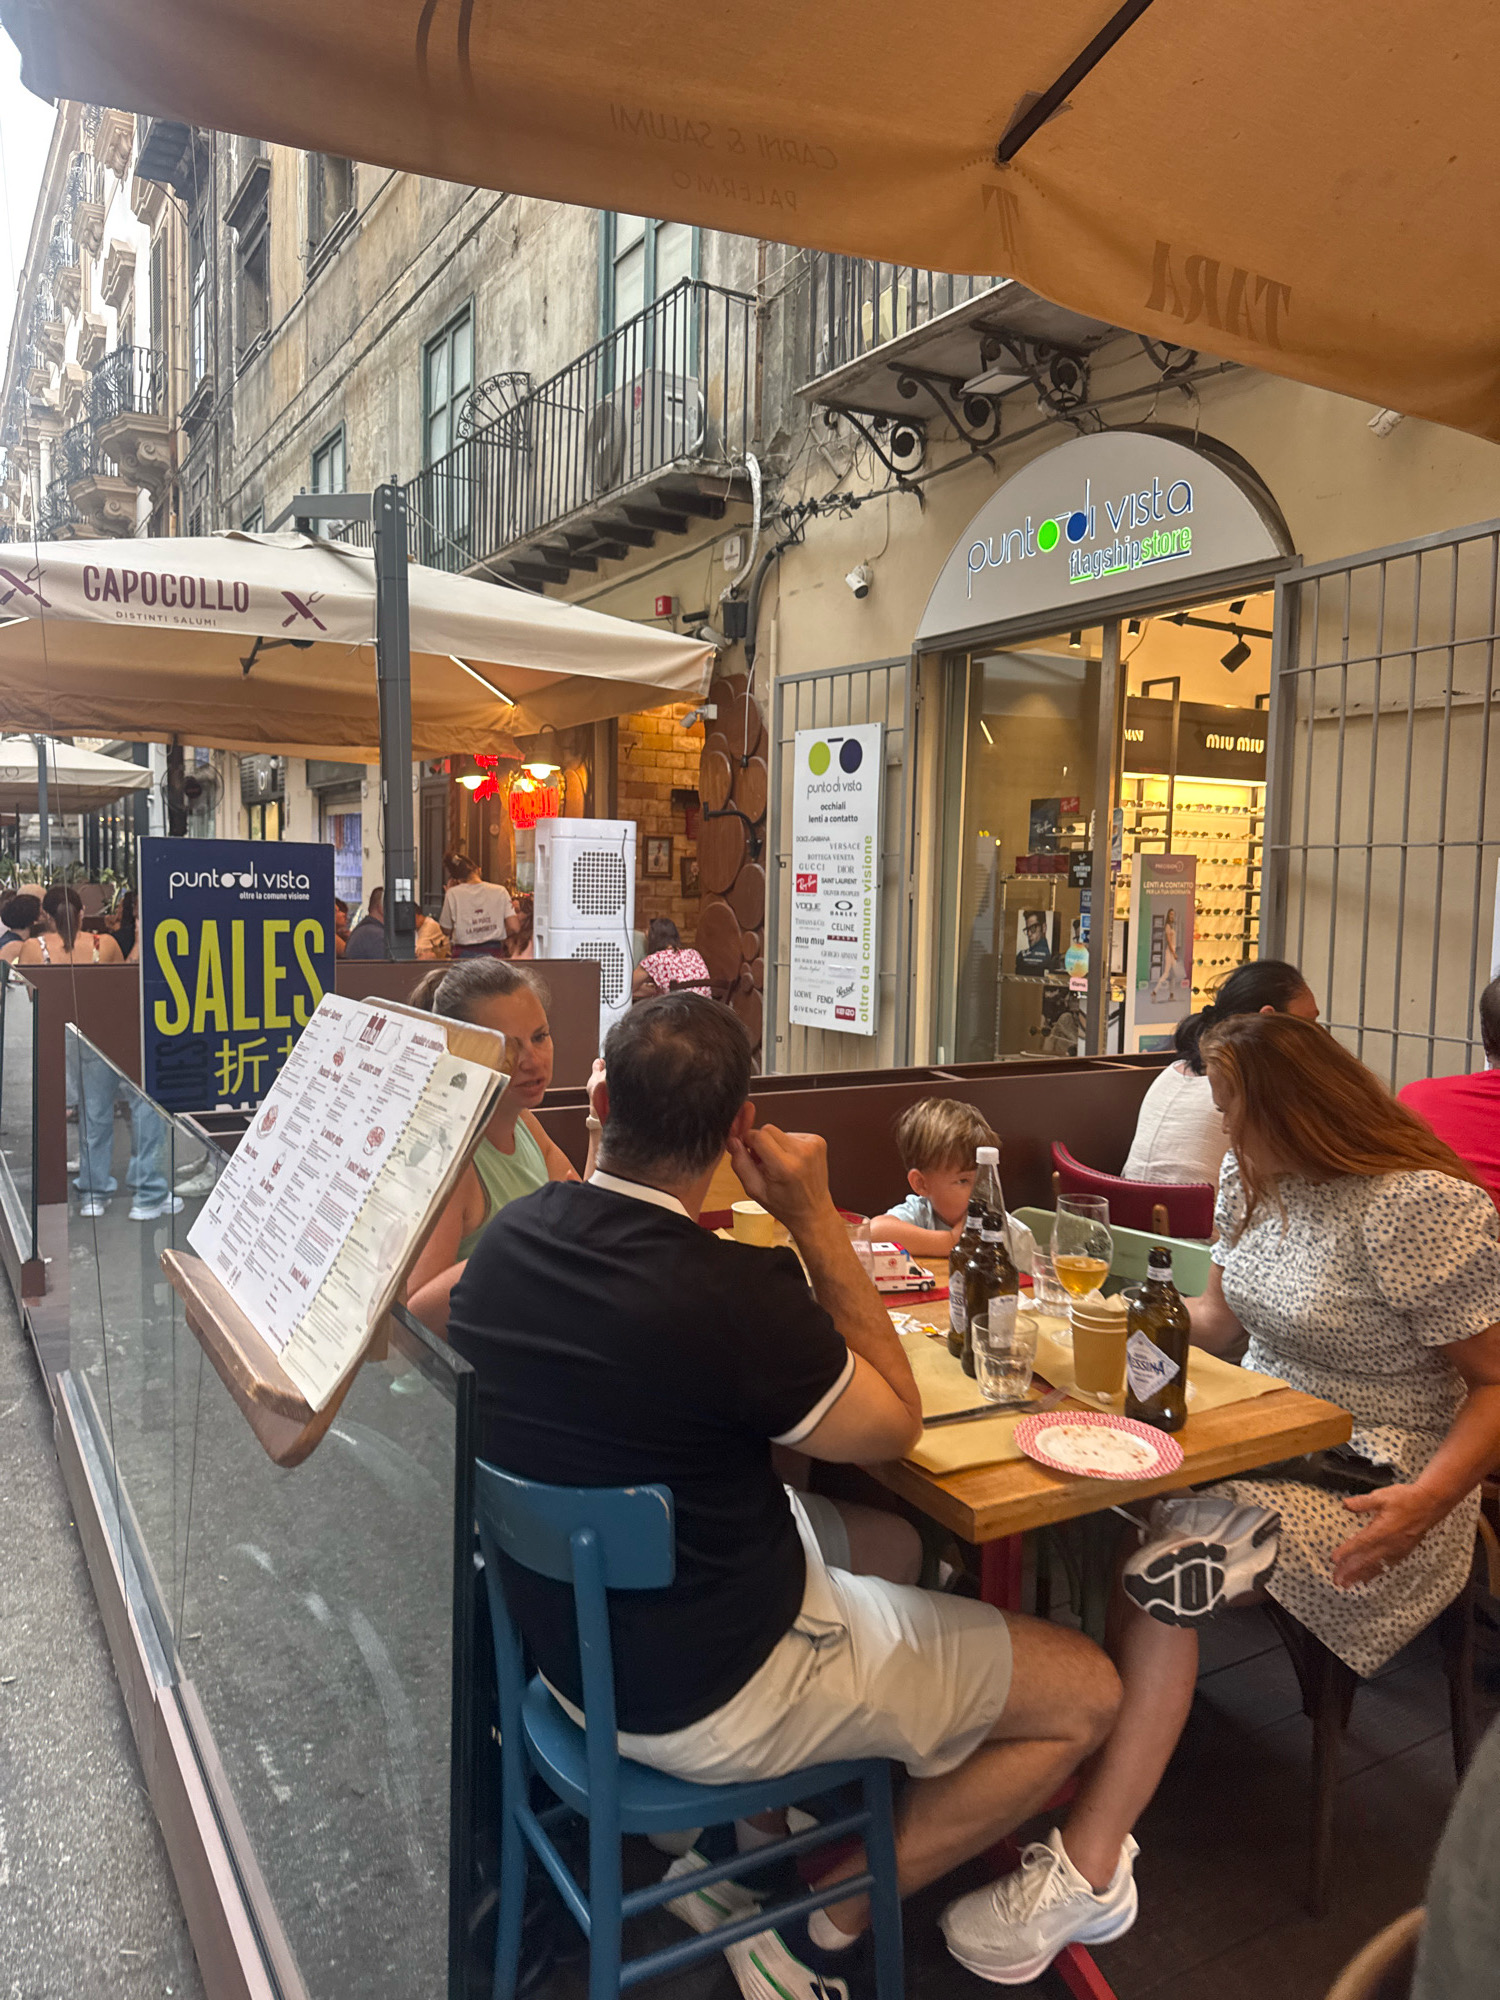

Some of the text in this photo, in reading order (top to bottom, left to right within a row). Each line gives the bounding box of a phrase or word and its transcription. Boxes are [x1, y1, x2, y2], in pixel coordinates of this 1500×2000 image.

[967, 476, 1194, 600] punto di vista
[83, 565, 249, 613] CAPOCOLLO
[116, 611, 217, 627] DISTINTI SALUMI
[842, 780, 862, 792] vista
[820, 801, 846, 811] occhiali
[808, 815, 823, 823] lenti
[829, 814, 858, 823] contatto
[830, 842, 860, 850] VERSACE
[799, 863, 825, 871] GUCCI
[169, 861, 310, 899] punto di vista
[239, 892, 255, 900] oltre
[256, 892, 263, 900] la
[288, 892, 310, 900] visione
[831, 923, 855, 932] CELINE
[859, 835, 873, 1022] oltre la comune visione
[154, 918, 325, 1036] SALES
[794, 990, 812, 999] LOEWE
[817, 995, 834, 1004] FENDI
[794, 1005, 827, 1015] GIVENCHY
